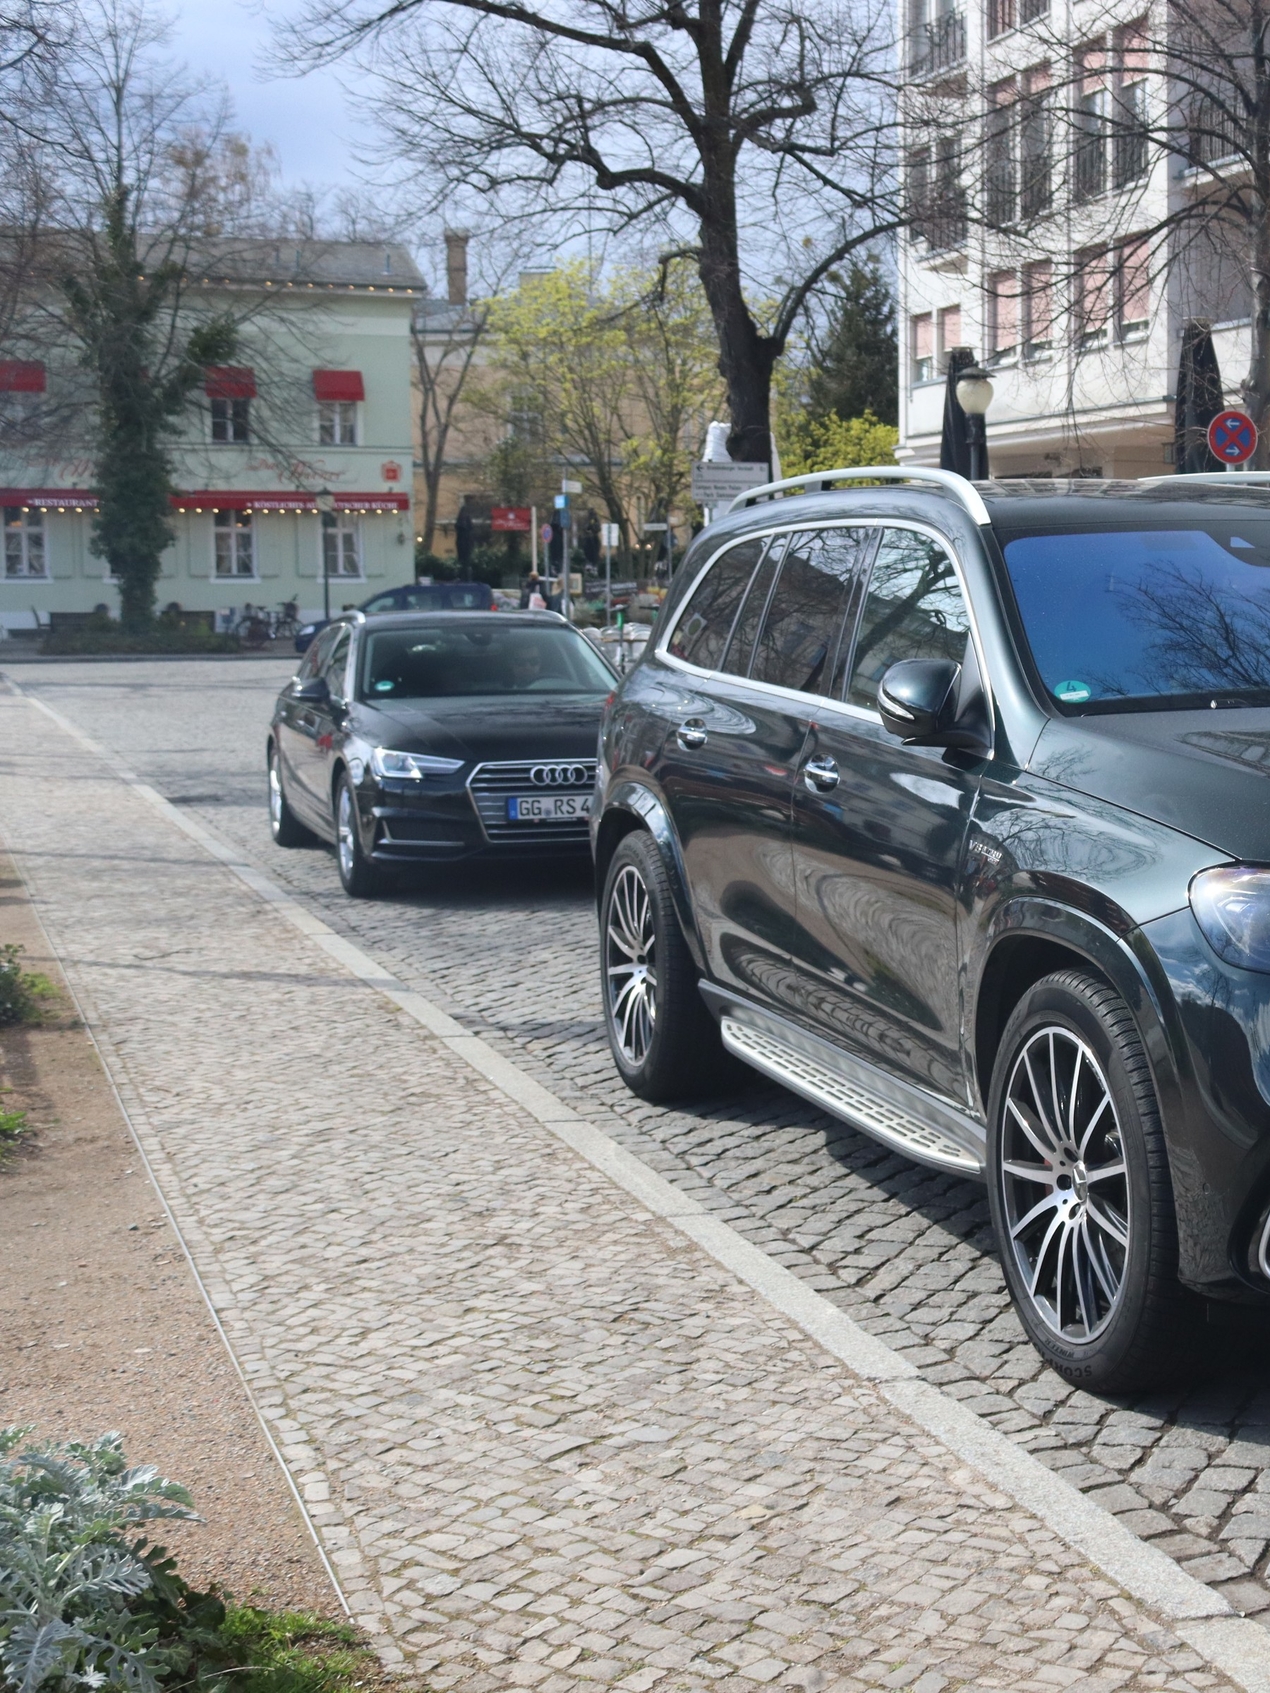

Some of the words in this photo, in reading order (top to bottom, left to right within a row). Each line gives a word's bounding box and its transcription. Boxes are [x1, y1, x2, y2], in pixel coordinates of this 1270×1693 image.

[34, 498, 100, 507] RESTAURANT
[519, 799, 542, 816] GG
[554, 798, 576, 815] RS
